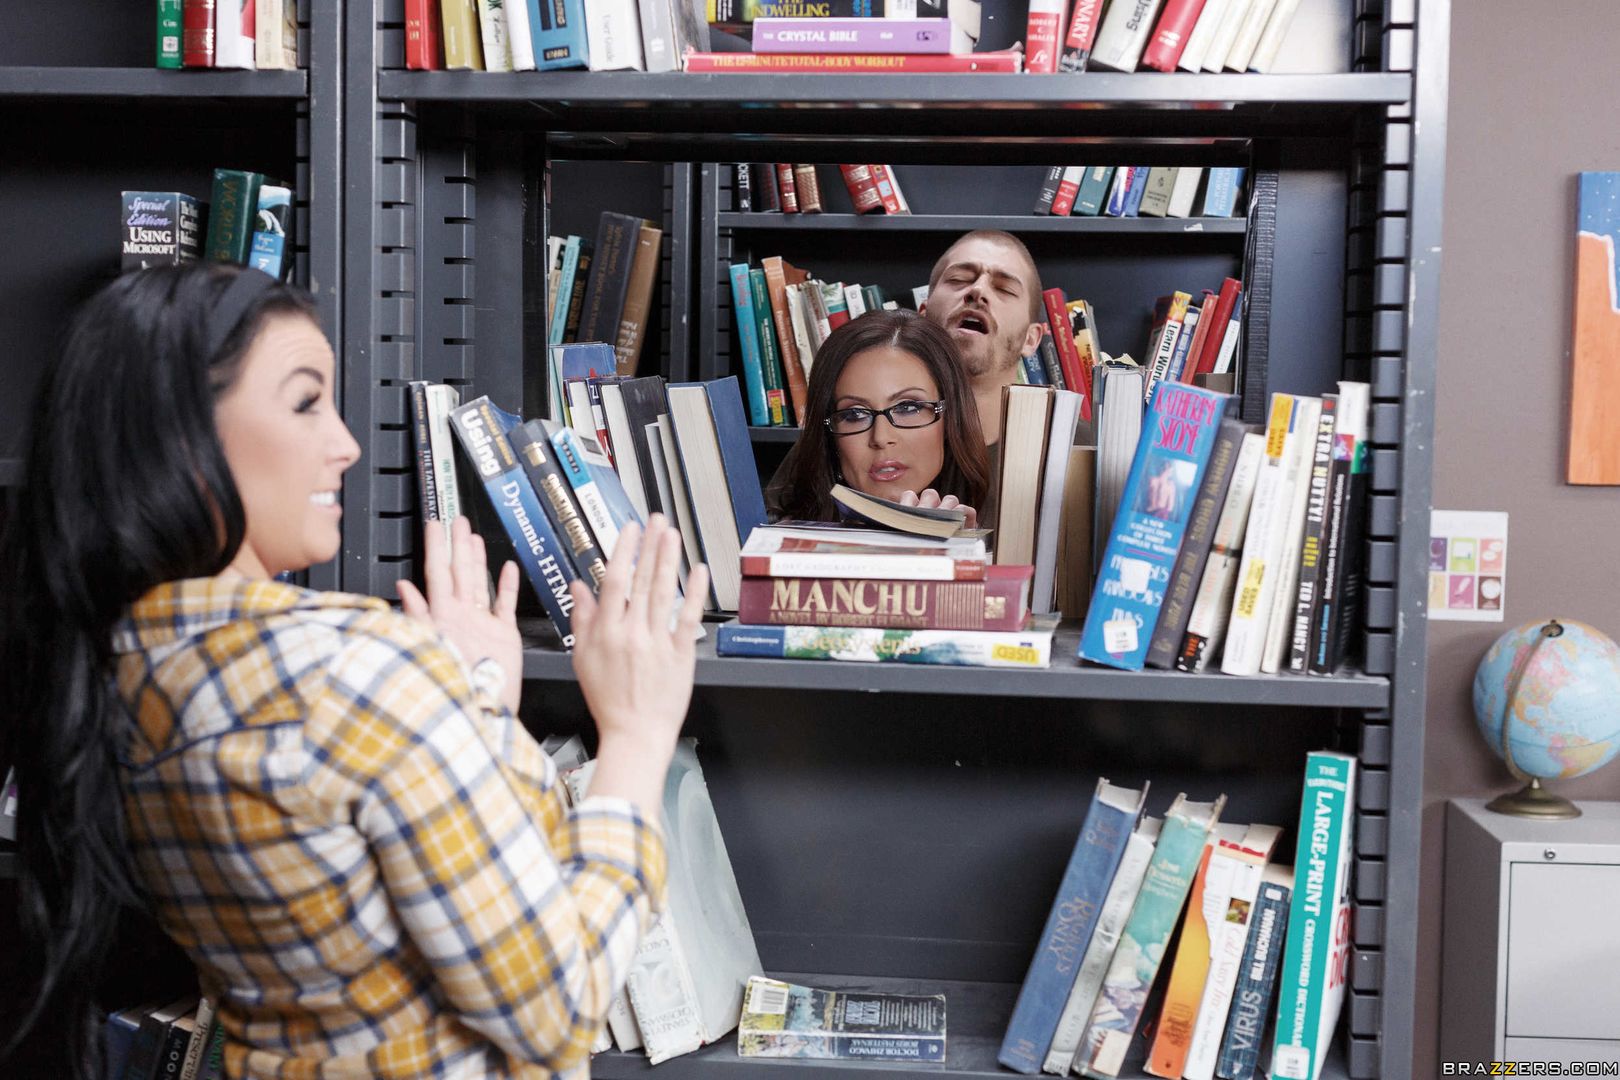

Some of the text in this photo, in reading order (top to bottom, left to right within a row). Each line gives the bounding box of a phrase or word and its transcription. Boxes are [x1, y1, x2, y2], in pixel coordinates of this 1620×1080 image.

[777, 31, 825, 42] CRYSTAL
[829, 31, 858, 42] BIBLE
[713, 56, 735, 67] THE
[853, 56, 906, 67] WORKOUT
[126, 212, 173, 227] Edition
[128, 196, 170, 215] Special
[123, 241, 176, 255] MICROSOFT
[129, 226, 172, 243] USING
[1163, 324, 1178, 353] Learn
[461, 408, 501, 477] Using
[480, 404, 513, 466] Special Edition
[1314, 414, 1334, 465] EXTRA
[423, 450, 431, 466] THE
[425, 469, 437, 512] TAPESTRY
[1307, 465, 1327, 523] NUTTY!
[585, 492, 606, 530] LONDON
[501, 480, 577, 618] Dynamic HTML
[1323, 558, 1335, 600] Introduction
[1329, 505, 1342, 549] International
[770, 578, 929, 616] MANCHU
[1299, 581, 1314, 602] TED
[777, 612, 811, 624] NOVEL
[816, 613, 830, 625] BY
[832, 613, 875, 627] ROBERT
[1293, 615, 1310, 652] NANCY
[996, 646, 1036, 662] USED
[1318, 765, 1338, 778] THE
[1304, 790, 1334, 917] LARGE-PRINT
[1299, 918, 1316, 987] CROSSWORD
[1250, 961, 1267, 982] BILL
[1231, 990, 1263, 1051] VIRUS
[849, 1047, 920, 1057] DOCTOR ZHIVAGO
